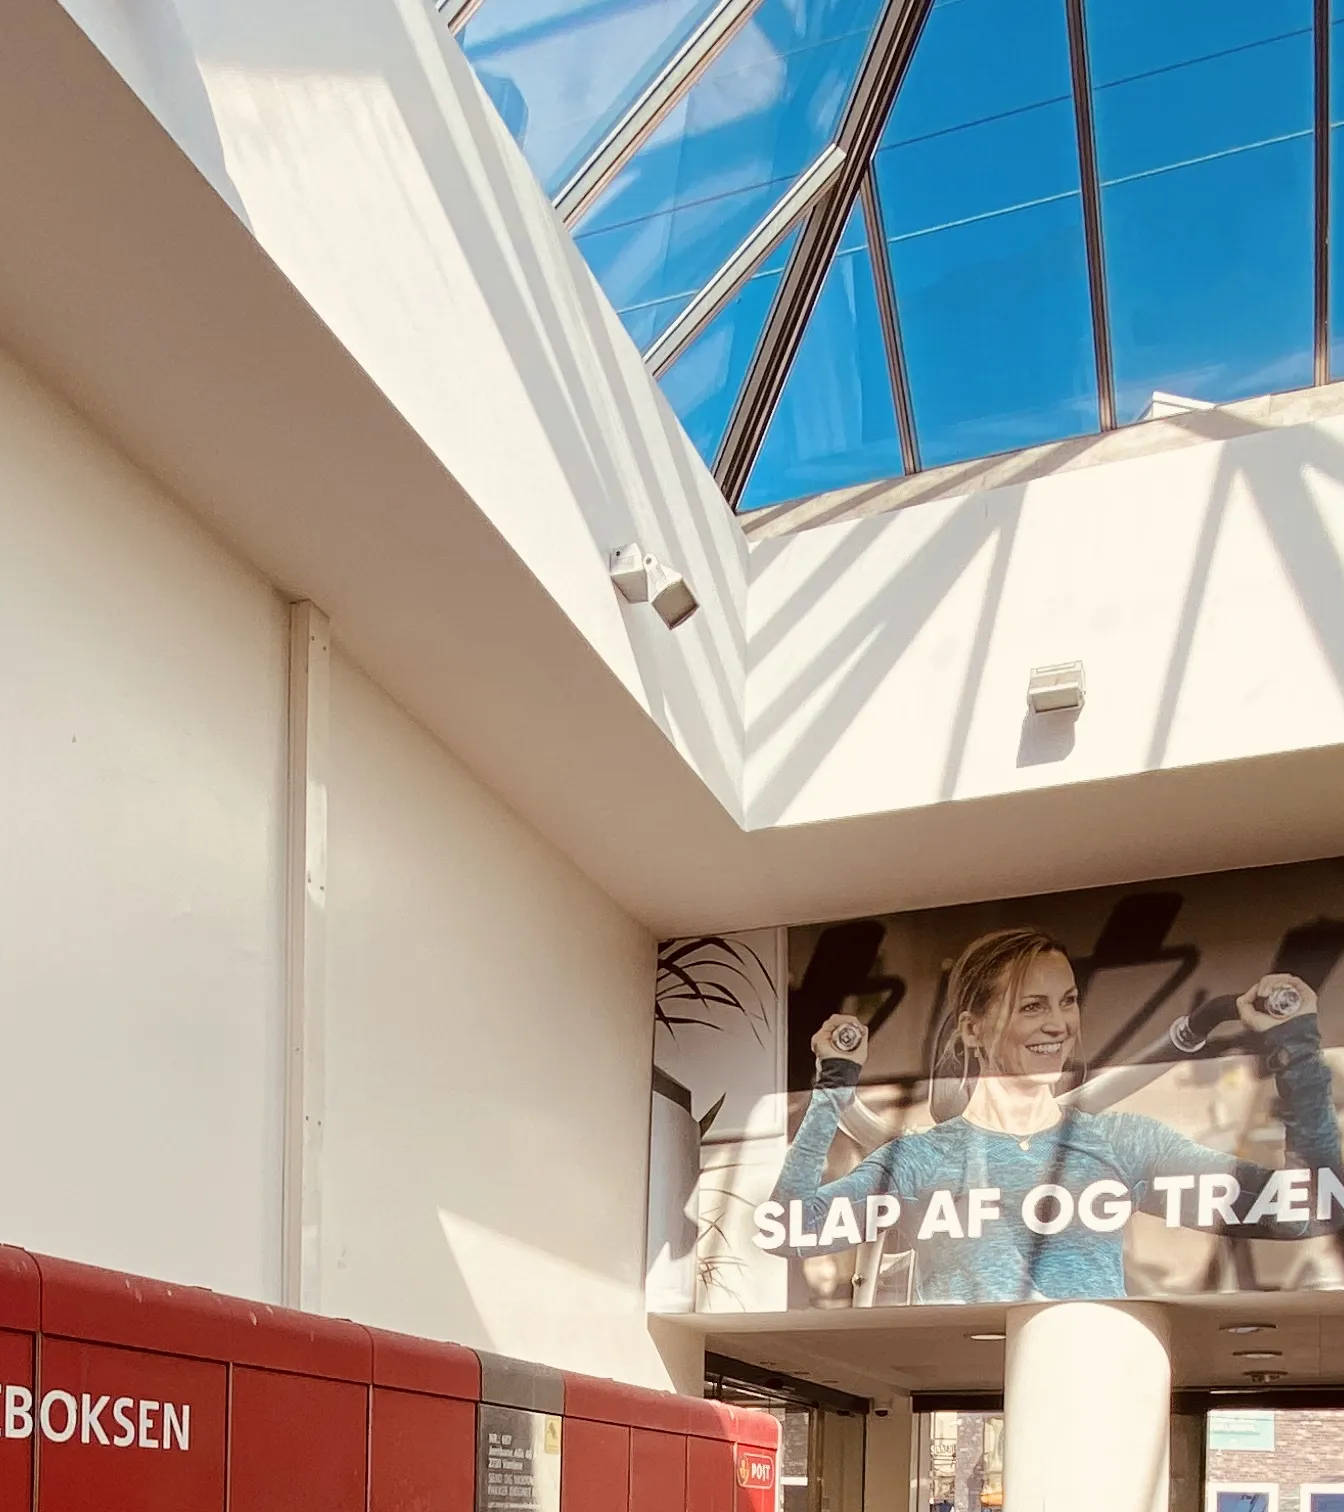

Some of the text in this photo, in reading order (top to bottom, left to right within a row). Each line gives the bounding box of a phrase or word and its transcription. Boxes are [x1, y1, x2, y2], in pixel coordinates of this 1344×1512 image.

[752, 1195, 901, 1253] SLAP
[918, 1187, 1001, 1242] AF
[1021, 1179, 1132, 1234] OG
